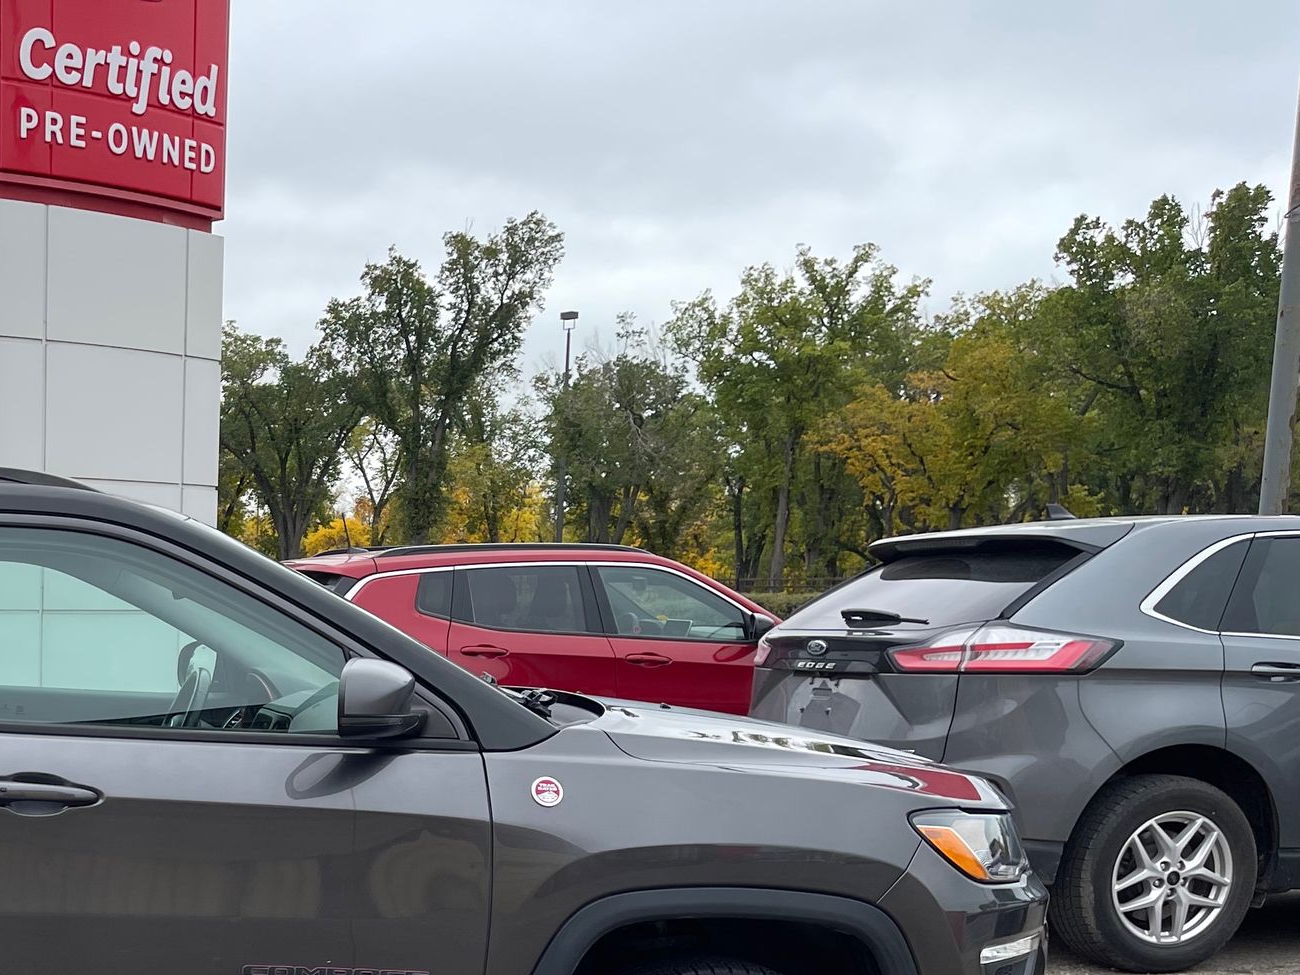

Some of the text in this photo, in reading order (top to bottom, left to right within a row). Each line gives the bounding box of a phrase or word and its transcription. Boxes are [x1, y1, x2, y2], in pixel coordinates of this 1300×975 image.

[19, 27, 219, 118] Certified
[20, 106, 216, 174] PRE-OWNED
[797, 661, 837, 669] EDGE
